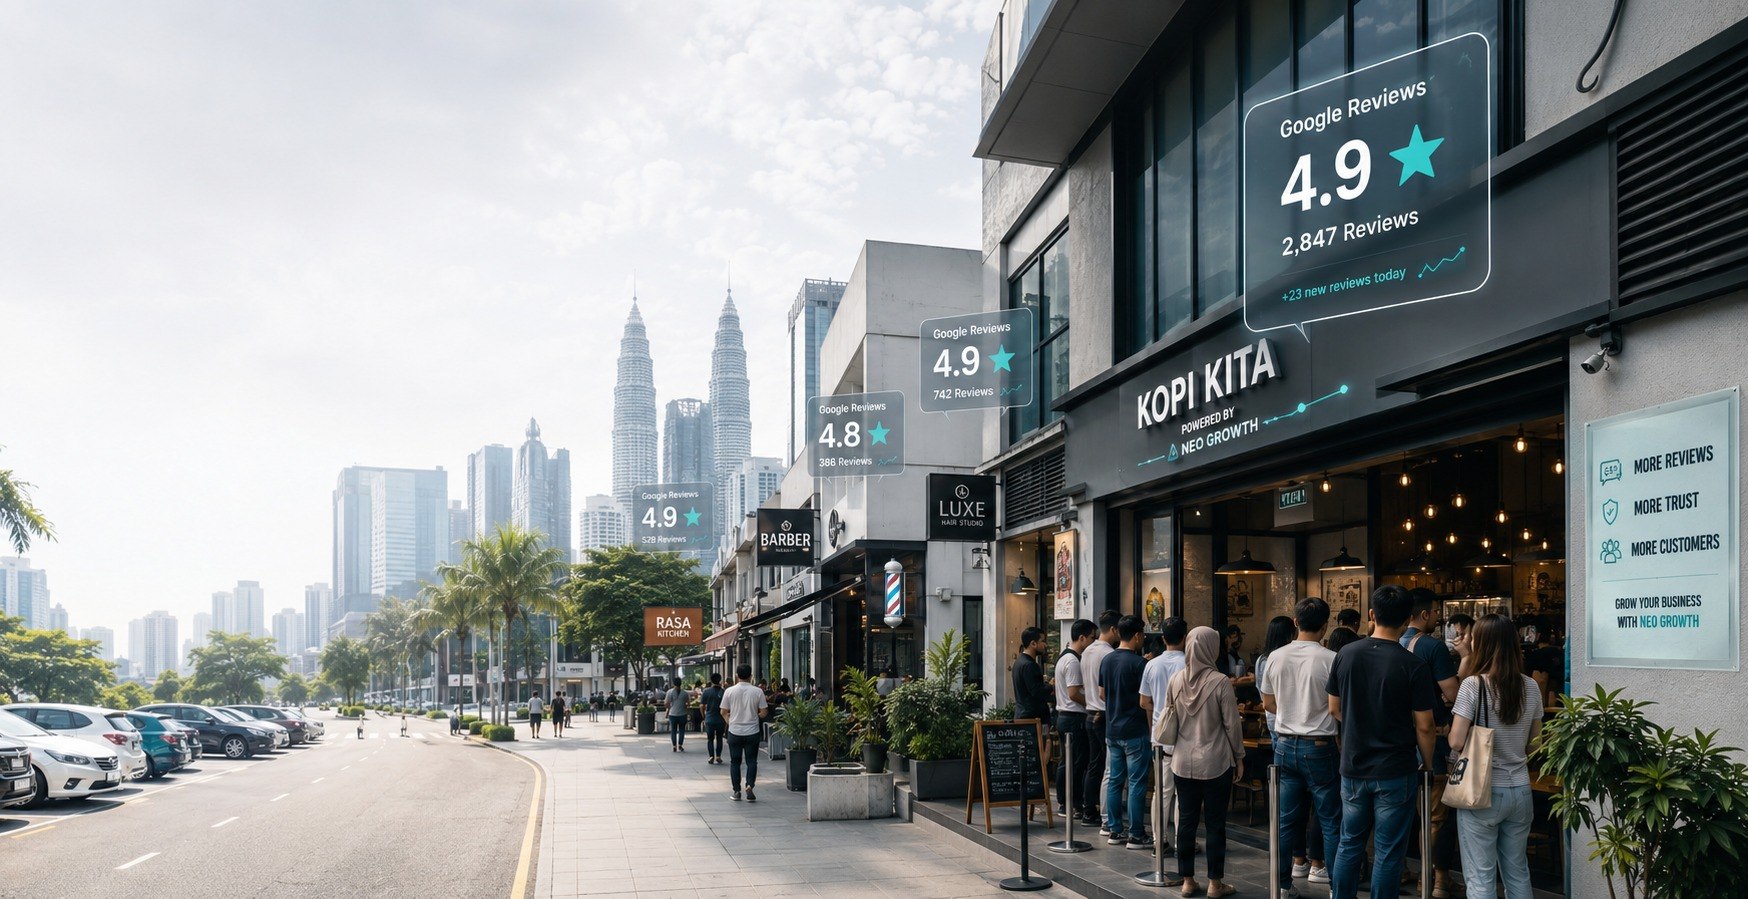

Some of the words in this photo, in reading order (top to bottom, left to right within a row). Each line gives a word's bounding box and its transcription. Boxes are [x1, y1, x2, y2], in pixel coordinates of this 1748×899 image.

[1137, 371, 1195, 430] KOPI
[1205, 338, 1277, 403] KITA
[1181, 413, 1222, 435] POWERED
[1223, 406, 1236, 421] BY
[1181, 436, 1204, 456] NEO
[1206, 417, 1259, 447] GROWTH
[1634, 455, 1662, 475] MORE
[1665, 444, 1714, 469] REVIEWS
[939, 500, 986, 518] LUXE
[1634, 497, 1662, 516] MORE
[1665, 491, 1700, 512] TRUST
[958, 519, 984, 527] STUDIO
[760, 533, 811, 547] BARBER
[1631, 539, 1657, 557] MORE
[1659, 533, 1720, 555] CUSTOMERS
[1615, 598, 1638, 610] GROW
[1639, 596, 1660, 609] YOUR
[1661, 594, 1702, 608] BUSINESS
[656, 616, 692, 629] RASA
[1617, 616, 1638, 628] WITH
[1639, 615, 1658, 628] NEO
[1660, 614, 1700, 628] GROWTH
